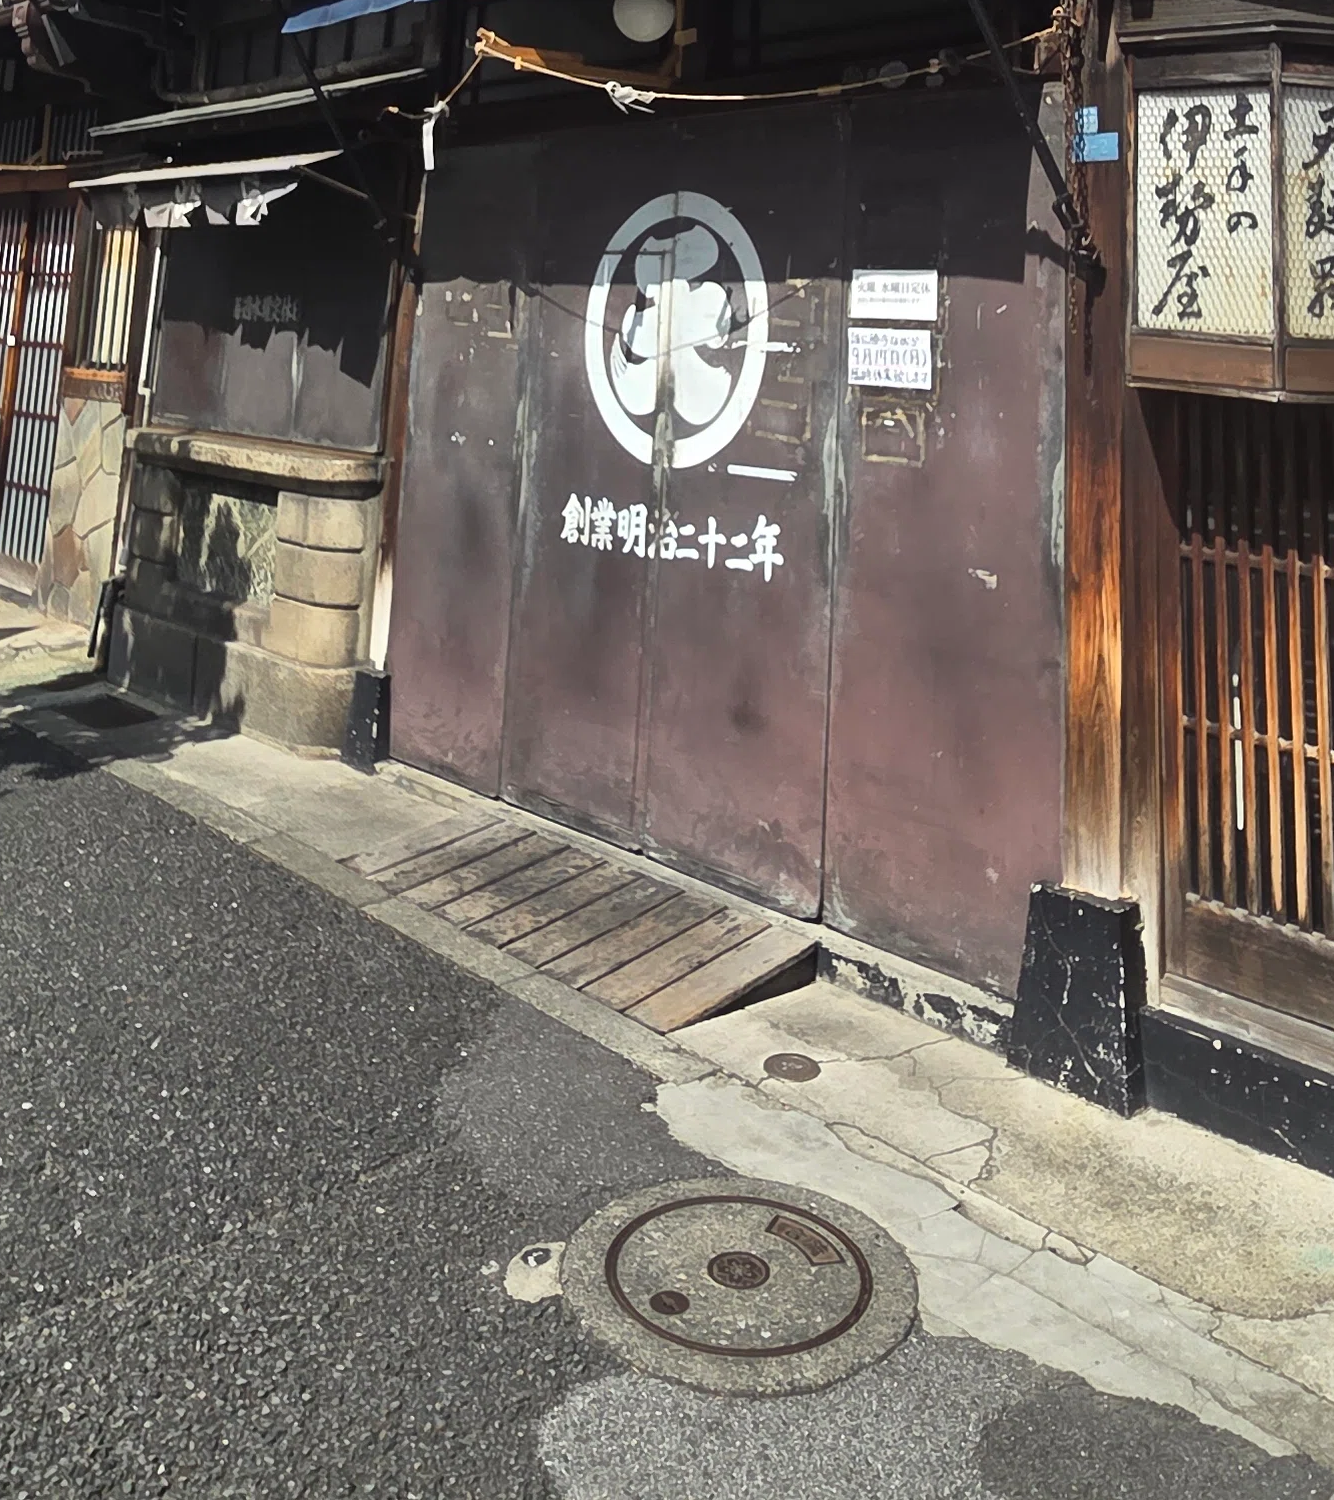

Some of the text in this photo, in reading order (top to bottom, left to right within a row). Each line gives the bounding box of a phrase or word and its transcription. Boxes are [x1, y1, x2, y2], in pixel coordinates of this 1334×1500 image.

[1151, 103, 1214, 322] 伊勢屋
[560, 492, 785, 583] 創業明治二十二年
